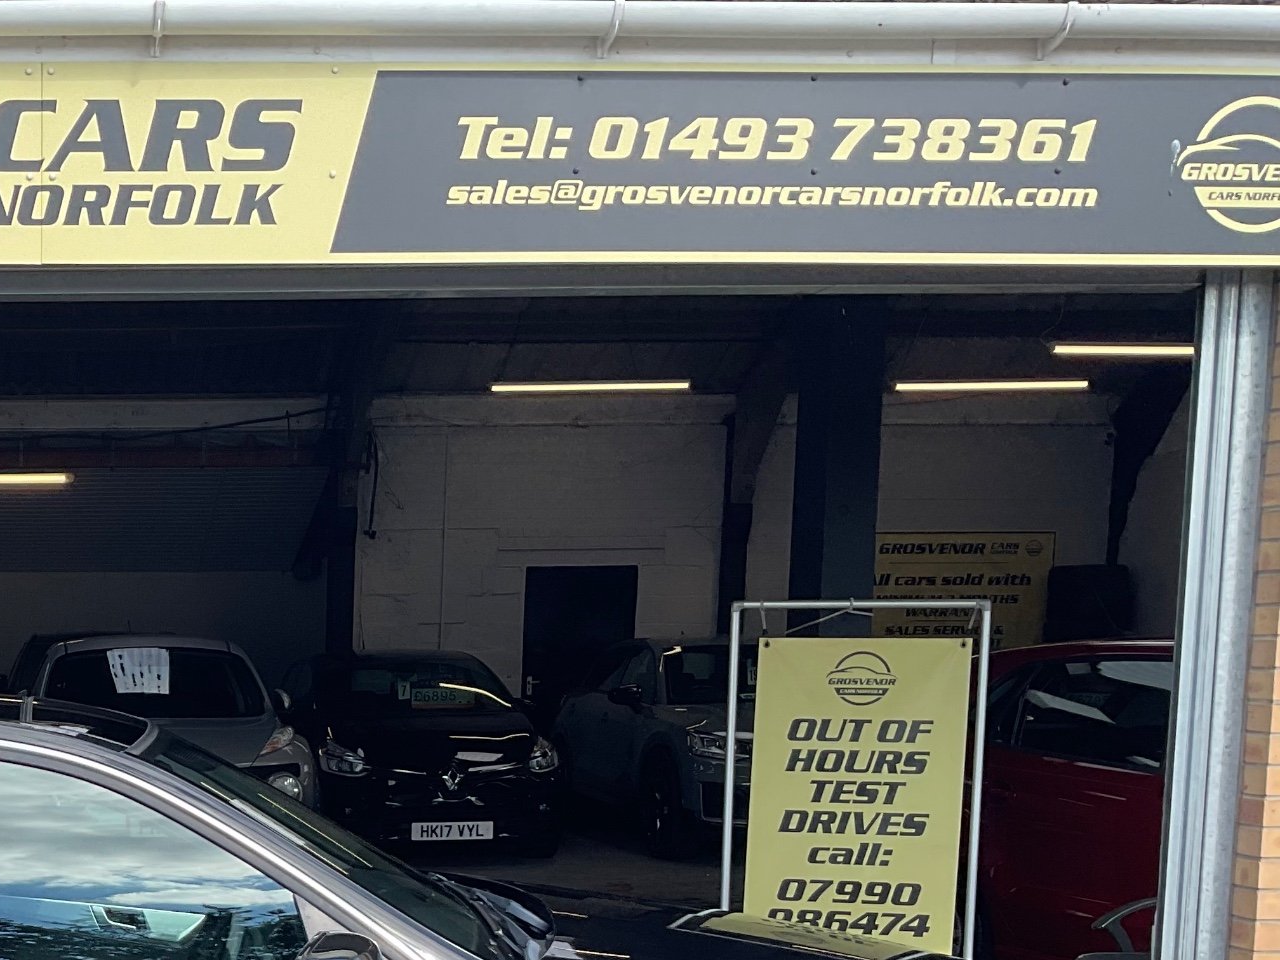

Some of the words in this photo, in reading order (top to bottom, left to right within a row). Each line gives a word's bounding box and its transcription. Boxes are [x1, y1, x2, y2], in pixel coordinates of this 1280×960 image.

[456, 116, 571, 160] Tel:
[588, 116, 814, 162] 01493
[831, 117, 1098, 163] 738361
[446, 179, 1098, 212] sales@grosvenorcarsnorfolk.com
[1208, 191, 1242, 201] CARS
[1244, 191, 1280, 201] NORF
[879, 542, 986, 555] GROSVENOR
[894, 575, 936, 586] cars
[941, 573, 984, 586] sold
[987, 573, 1032, 586] with
[905, 607, 974, 617] WARRAN
[885, 625, 930, 636] SALES
[828, 677, 897, 686] GROSVENOR
[786, 718, 872, 743] OUT
[876, 719, 934, 744] OF
[785, 749, 930, 774] HOURS
[809, 780, 907, 806] TEST
[420, 824, 453, 838] HK17
[457, 824, 484, 837] VYL
[778, 809, 930, 837] DRIVES
[807, 842, 893, 867] call:
[776, 878, 922, 906] 07990
